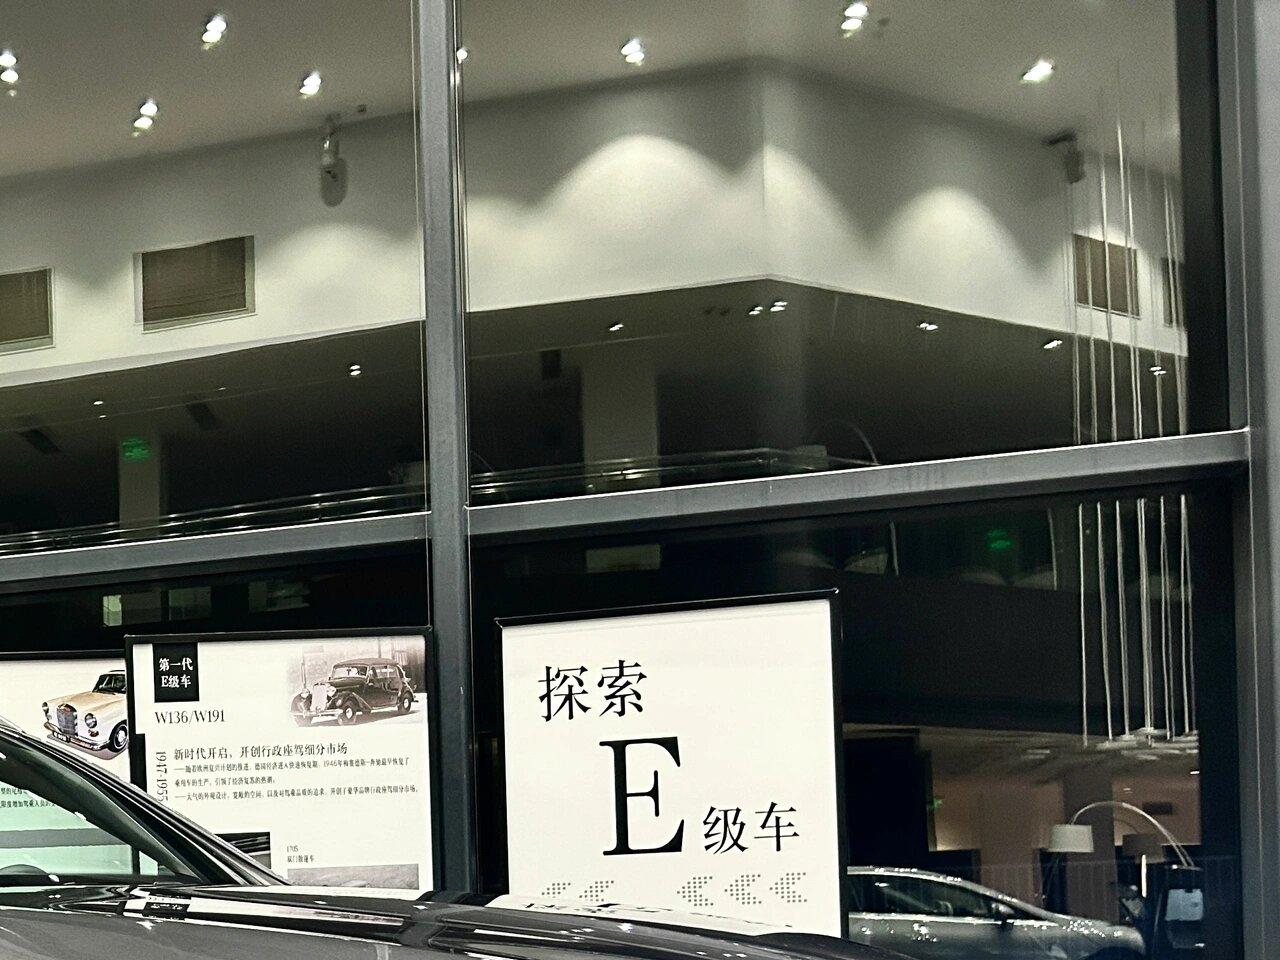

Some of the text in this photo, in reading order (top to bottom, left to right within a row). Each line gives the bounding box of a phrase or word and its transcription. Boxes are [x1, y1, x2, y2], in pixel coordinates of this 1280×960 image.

[159, 657, 193, 671] 第一代
[161, 674, 191, 688] E级车
[538, 659, 647, 722] 探索
[155, 709, 225, 725] W136/W191
